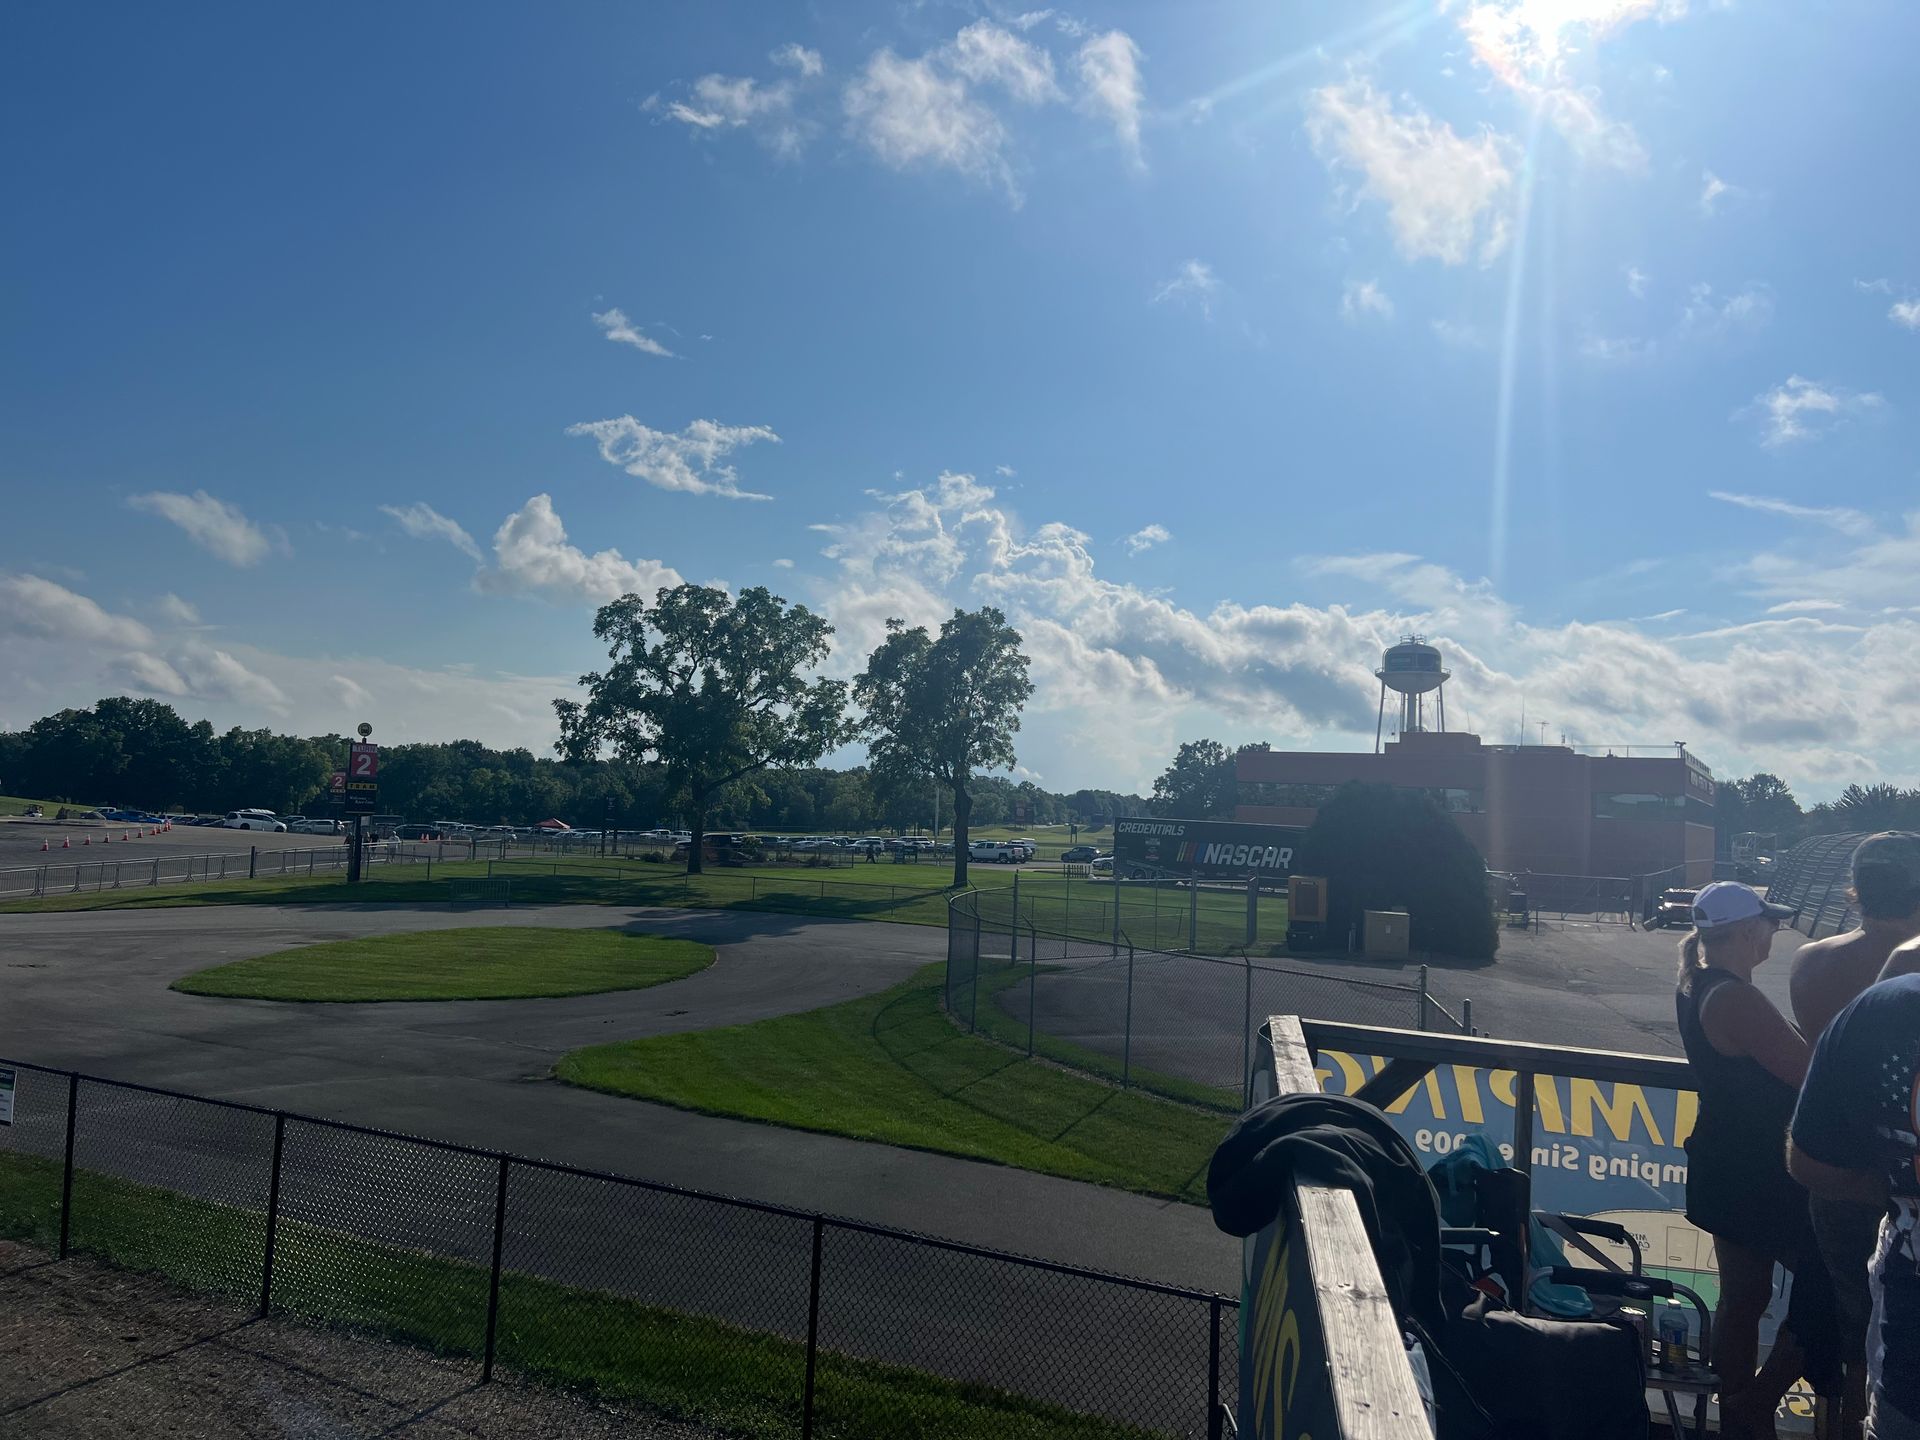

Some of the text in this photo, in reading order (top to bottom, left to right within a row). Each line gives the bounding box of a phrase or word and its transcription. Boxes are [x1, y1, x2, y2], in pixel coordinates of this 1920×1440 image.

[356, 754, 372, 775] 2
[335, 776, 343, 787] 2
[1118, 822, 1186, 836] CREDENTIALS
[1203, 842, 1294, 869] NASCAR
